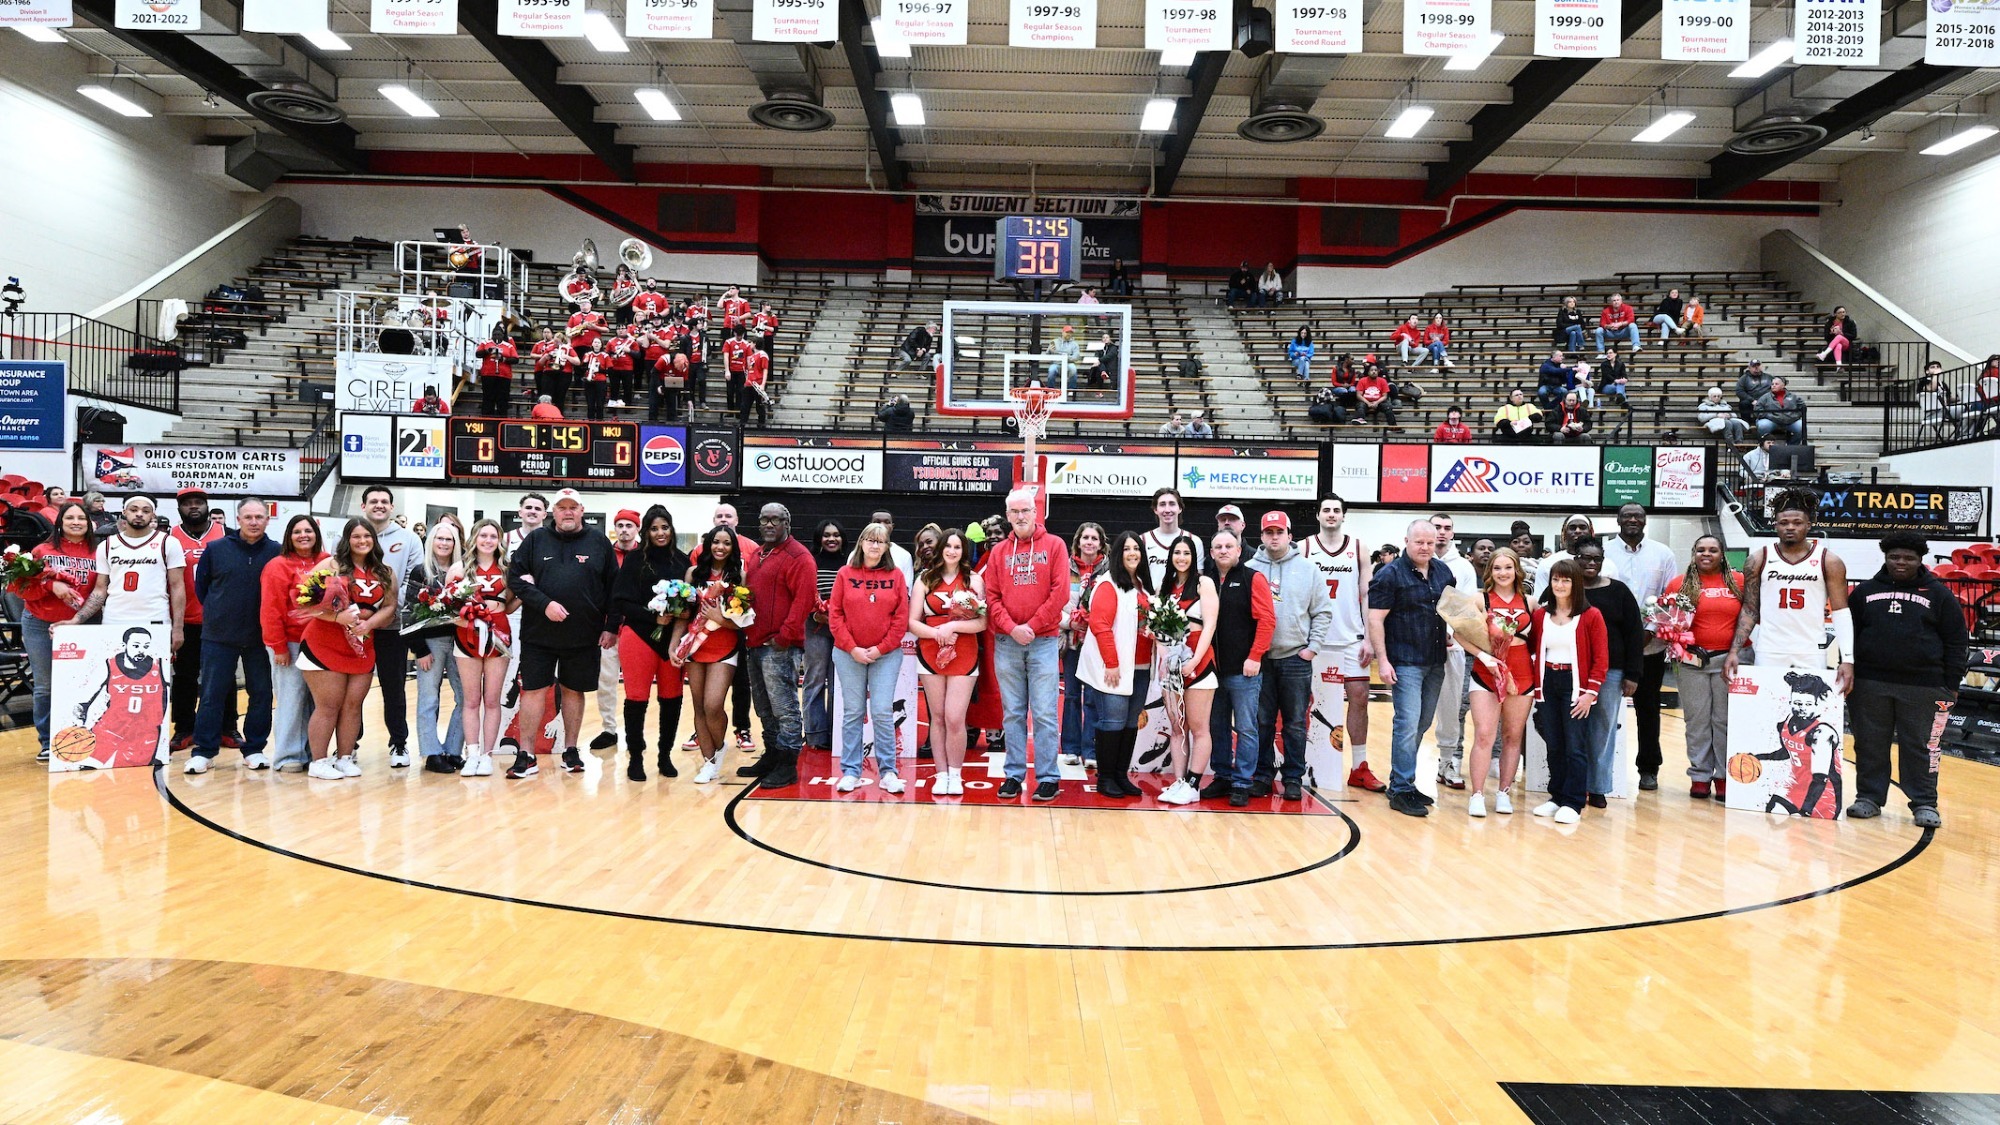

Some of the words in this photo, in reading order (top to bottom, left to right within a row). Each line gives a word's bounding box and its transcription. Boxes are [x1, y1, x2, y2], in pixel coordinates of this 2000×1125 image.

[386, 9, 416, 18] Regular
[899, 3, 952, 14] 1996-97
[1027, 6, 1080, 17] 1997-98
[1292, 8, 1346, 19] 1997-98
[1807, 9, 1863, 19] 2012-2013
[132, 14, 188, 24] 2021-2022
[513, 12, 543, 21] Regular
[1163, 9, 1216, 20] 1997-98
[1421, 14, 1474, 25] 1998-99
[393, 19, 435, 28] Champions
[521, 22, 563, 31] Champions
[895, 20, 925, 28] Regular
[1550, 16, 1603, 27] 1999-00
[1679, 15, 1732, 27] 1999-00
[1024, 23, 1053, 31] Regular
[1807, 22, 1863, 32] 2014-2015
[1935, 24, 1995, 34] 2015-2016
[903, 30, 946, 39] Champions
[1031, 34, 1073, 42] Champions
[1417, 31, 1447, 40] Regular
[1552, 33, 1598, 41] Tournament
[1806, 35, 1863, 44] 2018-2019
[1167, 36, 1210, 45] Champions
[1425, 41, 1468, 50] Champions
[1935, 38, 1994, 48] 2017-2018
[1554, 43, 1597, 52] Champions
[1806, 47, 1863, 57] 2021-2022
[950, 194, 1029, 213] STUDENT
[1033, 196, 1107, 215] SECTION
[1022, 218, 1069, 237] 7:45
[1017, 241, 1060, 275] 30
[465, 422, 484, 434] YSU
[400, 428, 432, 455] 21
[522, 425, 583, 450] 7:45
[478, 438, 493, 461] 0
[616, 441, 631, 465] 0
[144, 449, 176, 460] OHIO
[180, 450, 237, 461] CUSTOM
[242, 451, 287, 462] CARTS
[645, 451, 682, 460] PEPSI
[922, 455, 950, 466] OFFICIAL
[951, 456, 971, 466] GUINS
[972, 456, 990, 467] GEAR
[146, 461, 173, 469] SALES
[175, 462, 239, 470] RESTORATION
[243, 463, 284, 472] RENTALS
[400, 456, 443, 467] WFMJ
[521, 460, 550, 470] PERIOD
[756, 453, 865, 472] eastwood
[472, 464, 499, 474] BONUS
[588, 468, 615, 477] BONUS
[912, 467, 999, 481] YSUBOOKSTORE.COM
[240, 472, 255, 480] OH
[781, 473, 810, 483] MALL
[812, 474, 864, 484] COMPLEX
[1210, 473, 1314, 485] MERCYHEALTH
[1551, 472, 1595, 487] RITE
[177, 480, 249, 489] 330-787-7405
[919, 481, 928, 491] OR
[929, 481, 938, 491] AT
[939, 481, 957, 492] FIFTH
[958, 482, 964, 492] &
[964, 482, 992, 493] LINCOLN
[1661, 480, 1688, 490] PIZZA
[1853, 491, 1944, 510] TRADER
[1817, 511, 1939, 521] HALLENGE
[1857, 522, 1882, 530] VERSION
[1893, 523, 1919, 531] FANTASY
[1920, 523, 1949, 532] FOOTBALL
[110, 555, 158, 570] Penguins
[123, 571, 140, 592] 0
[848, 577, 896, 590] YSU
[1013, 573, 1038, 586] STATE
[1767, 570, 1819, 586] Penguins
[355, 579, 382, 598] Y
[476, 575, 503, 593] Y
[1325, 579, 1340, 600] 7
[932, 591, 953, 610] Y
[1779, 588, 1806, 611] 15
[1982, 649, 2000, 664] Y
[1326, 666, 1339, 675] #7
[112, 683, 160, 694] YSU
[128, 695, 143, 714] 0
